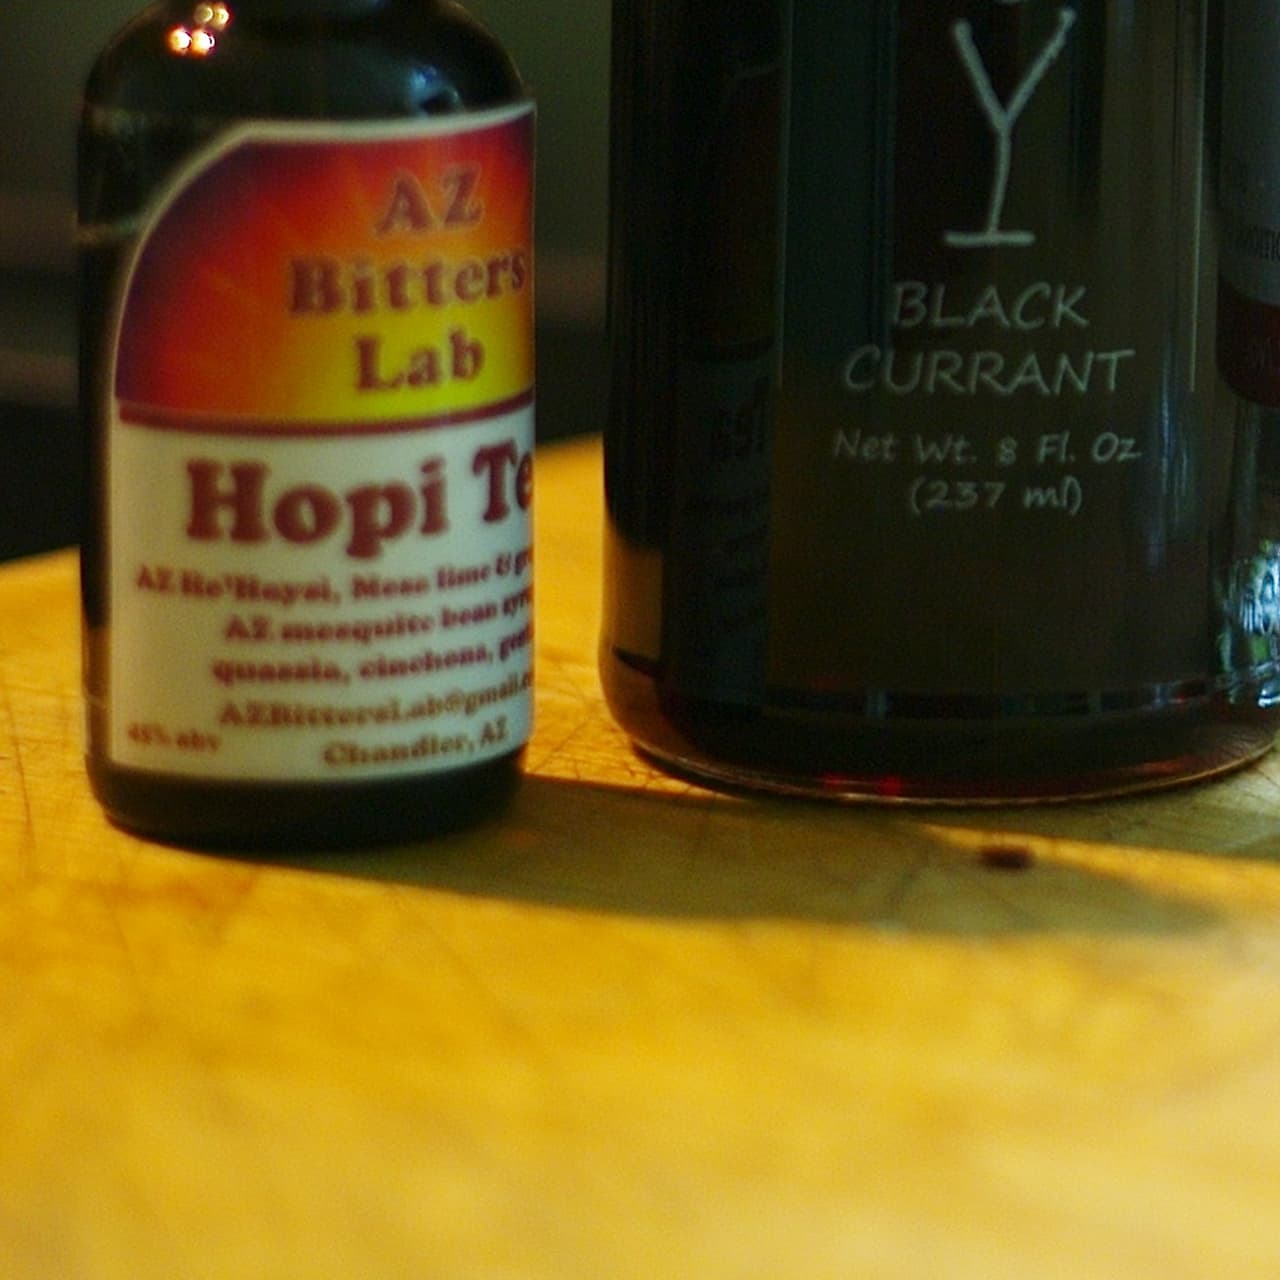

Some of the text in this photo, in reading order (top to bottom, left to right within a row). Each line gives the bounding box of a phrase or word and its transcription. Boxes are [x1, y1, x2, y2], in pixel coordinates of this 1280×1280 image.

[373, 163, 483, 239] AZ
[288, 246, 526, 315] Bitters
[891, 281, 1089, 329] BLACK
[355, 330, 484, 393] Lab
[844, 345, 1136, 395] CURRANT
[833, 430, 897, 461] Net
[1000, 437, 1017, 464] 8
[1092, 432, 1142, 460] Oz
[185, 455, 450, 559] Hopi
[911, 477, 1006, 514] (237
